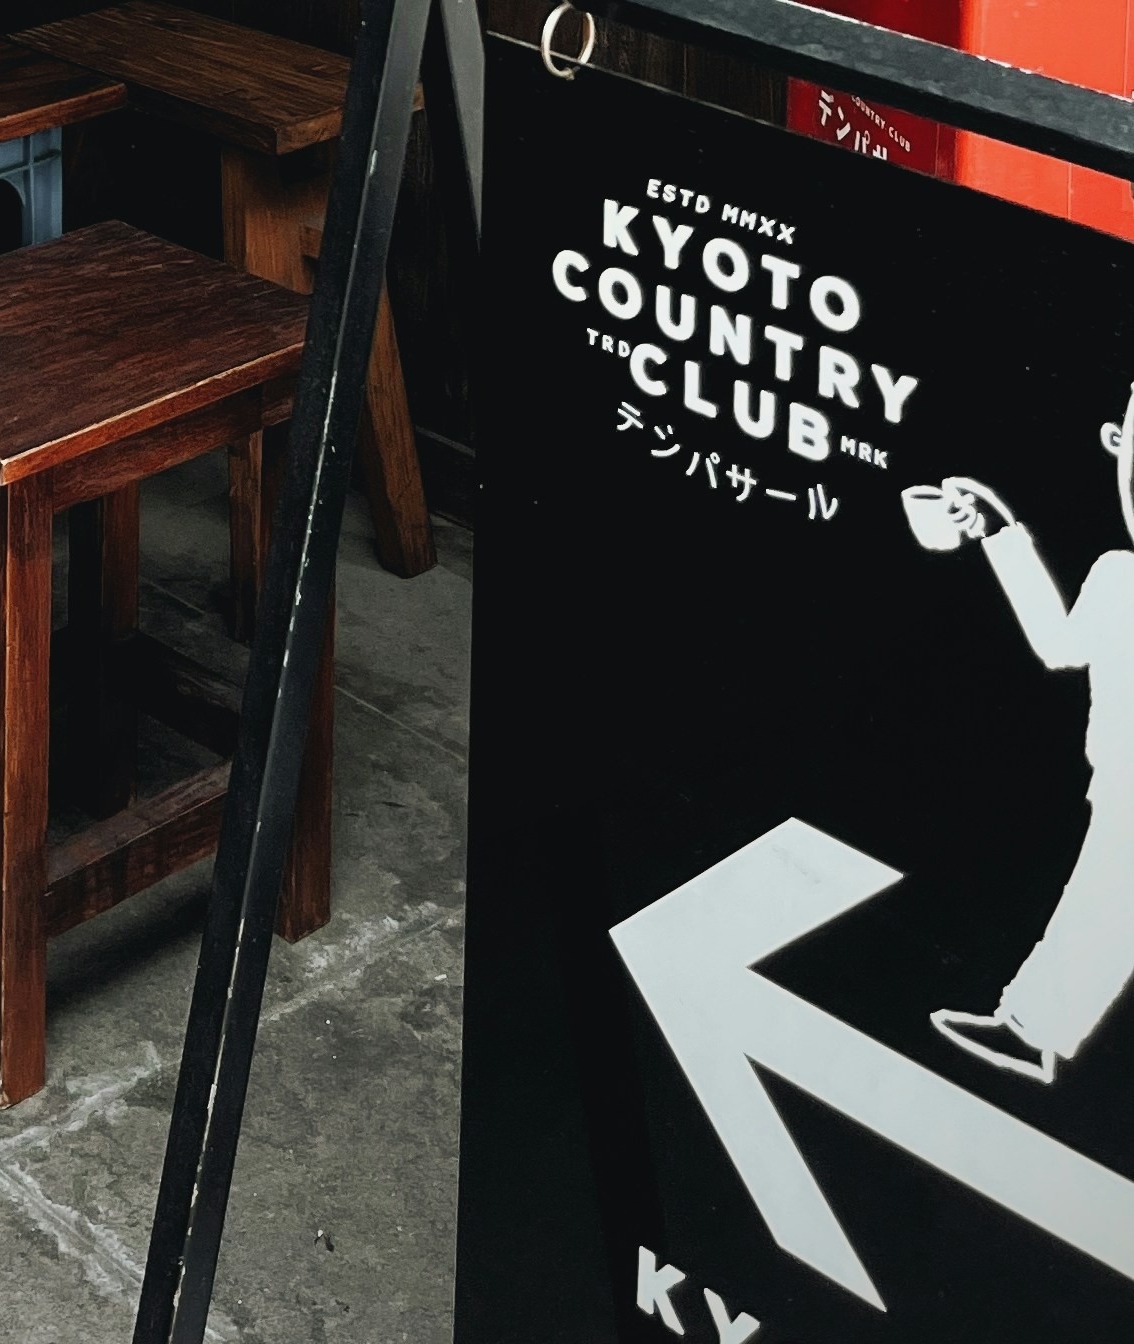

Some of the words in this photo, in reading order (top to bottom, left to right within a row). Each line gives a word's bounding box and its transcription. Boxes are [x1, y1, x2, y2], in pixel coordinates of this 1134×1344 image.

[888, 126, 911, 153] CLUB
[603, 198, 861, 332] KYOTO
[646, 178, 711, 214] ESTD
[721, 203, 797, 246] MMXX
[552, 249, 918, 424] COUNTRY
[586, 327, 631, 358] TRD
[629, 343, 830, 462] CLUB
[840, 435, 888, 469] MRK
[636, 1245, 761, 1344] KY
